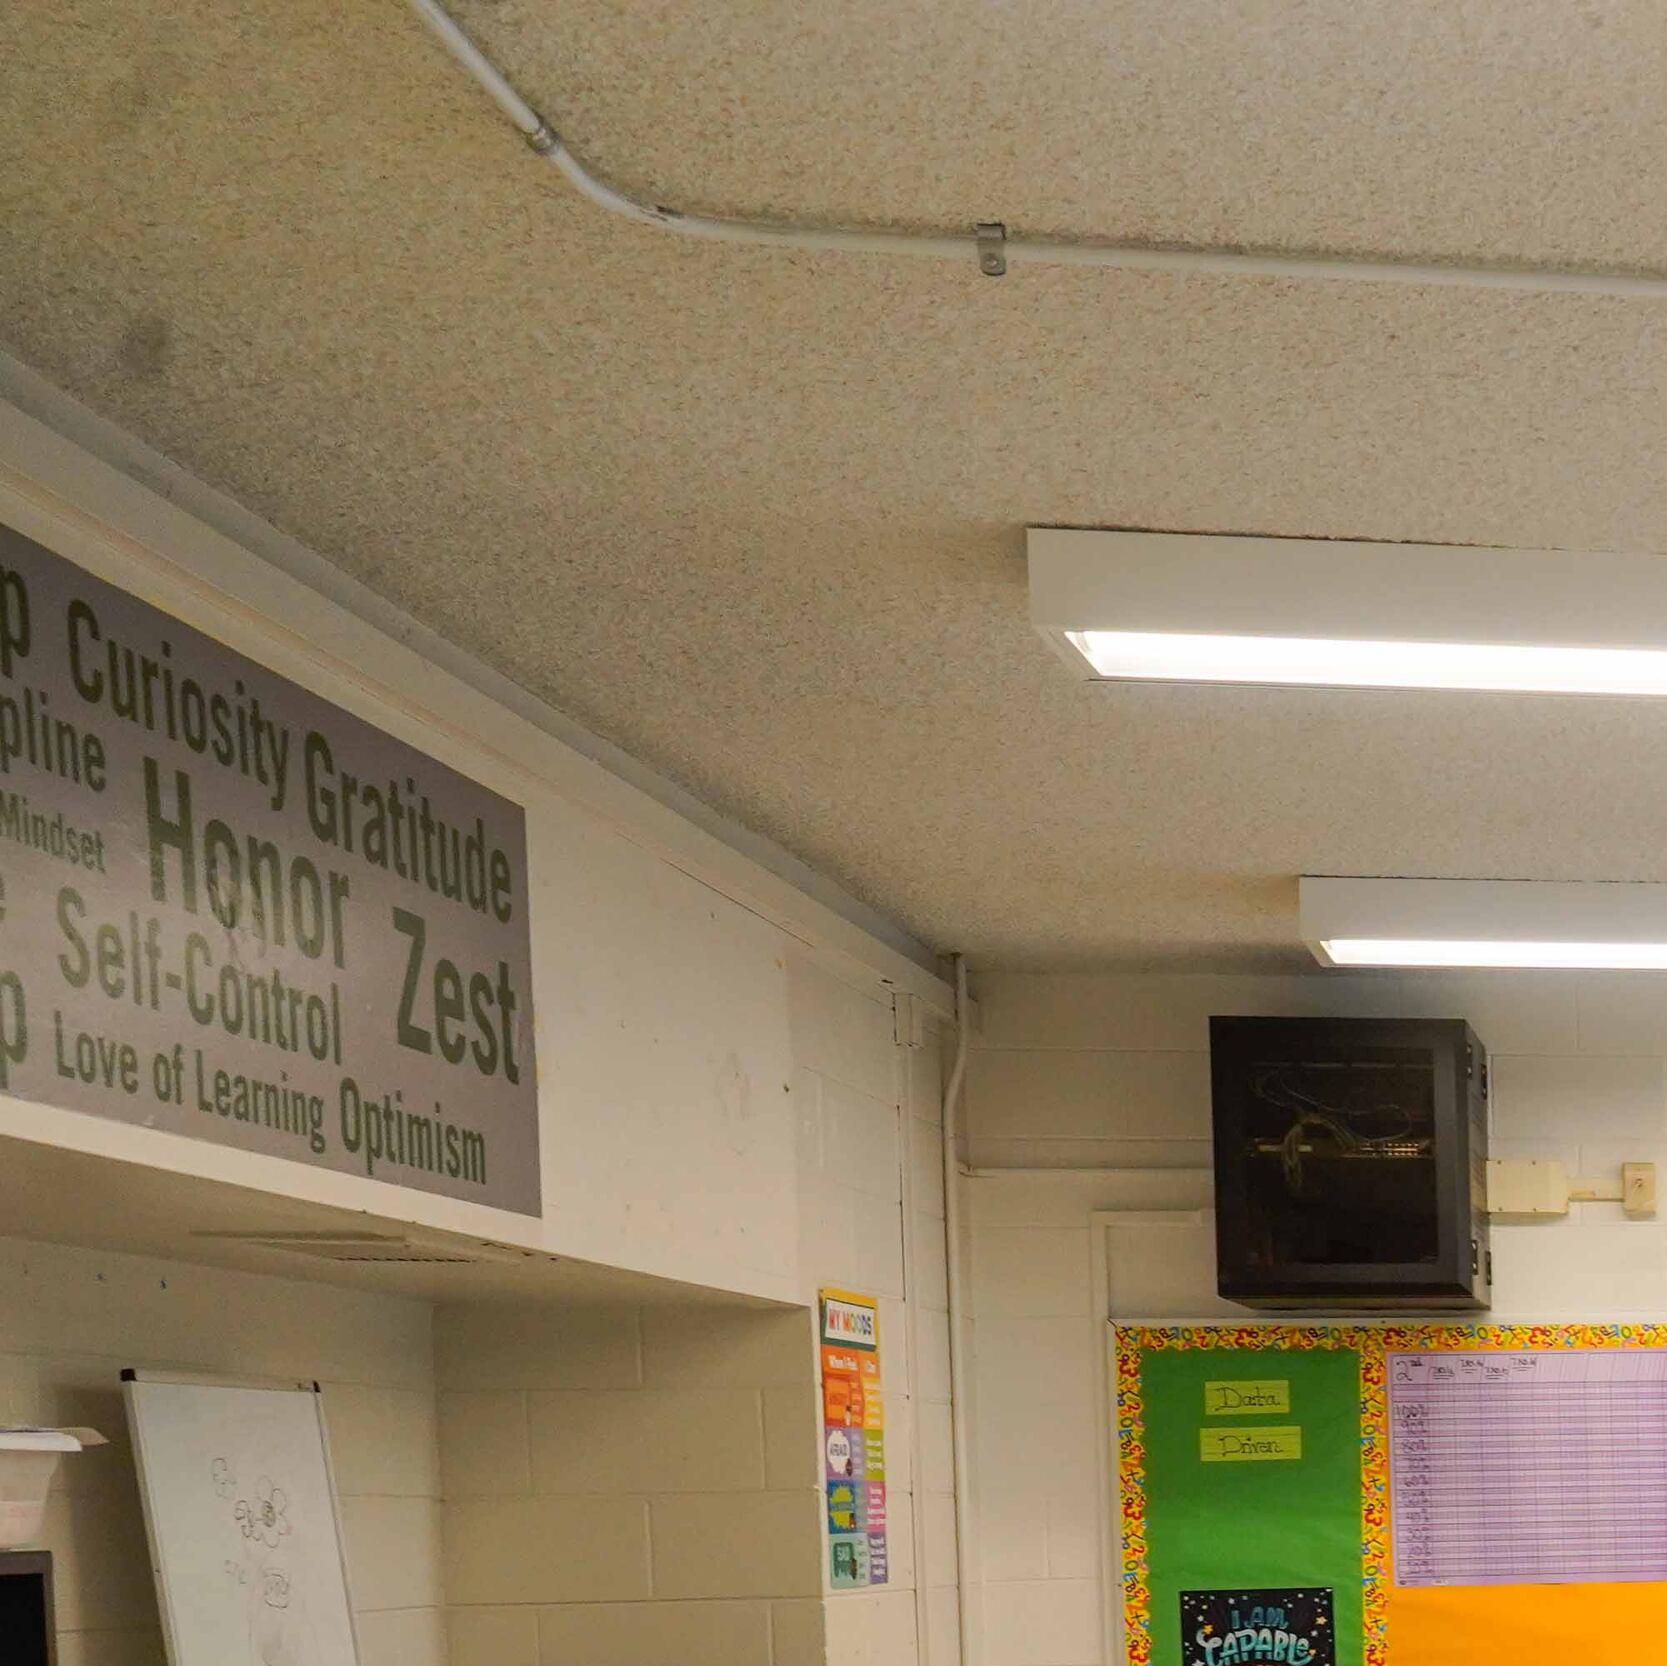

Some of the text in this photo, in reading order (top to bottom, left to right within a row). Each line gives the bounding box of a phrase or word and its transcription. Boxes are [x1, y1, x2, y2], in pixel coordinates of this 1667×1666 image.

[67, 600, 289, 811] Curiosity
[305, 731, 513, 925] Gratitude
[143, 755, 519, 1085] Honor Zest
[56, 887, 341, 1065] Self-Control
[54, 1010, 486, 1185] Love of Learning Optimism
[828, 1308, 872, 1336] MY MOODS
[1215, 1386, 1281, 1411] Data
[1217, 1435, 1284, 1457] Driven
[1246, 1606, 1288, 1629] AM
